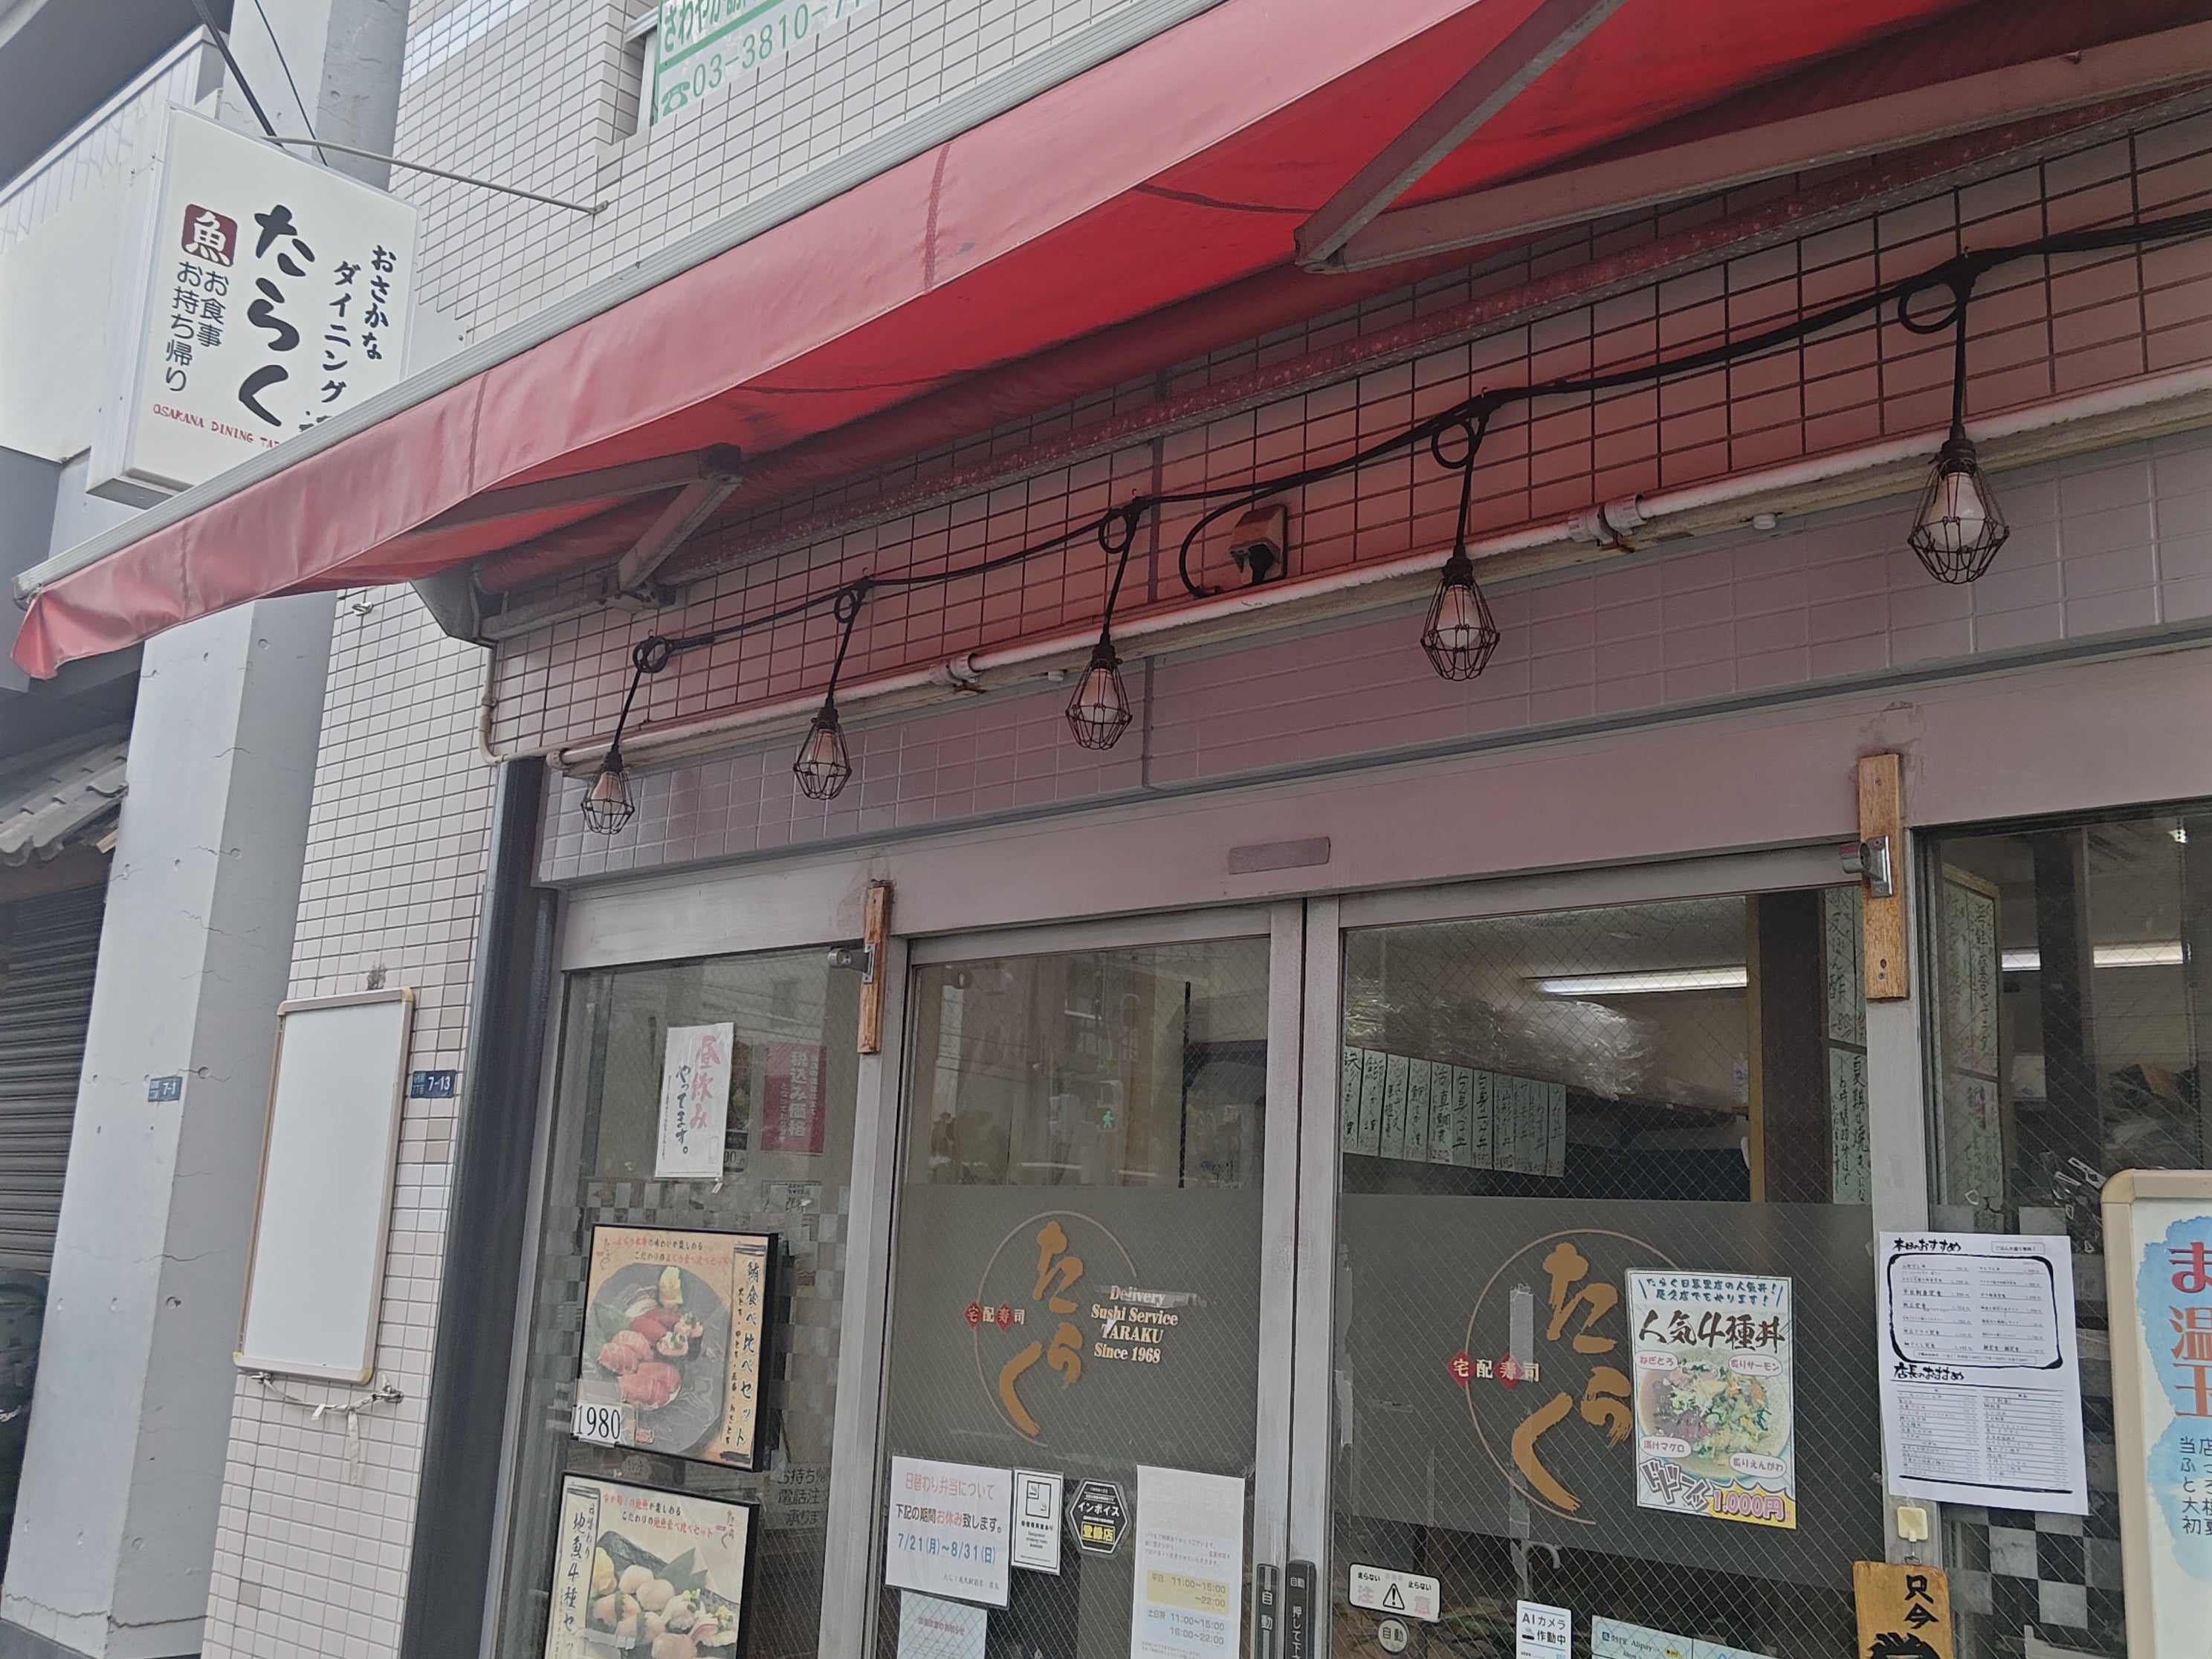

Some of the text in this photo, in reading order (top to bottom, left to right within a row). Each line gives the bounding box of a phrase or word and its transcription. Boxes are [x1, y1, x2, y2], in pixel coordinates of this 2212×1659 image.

[693, 0, 858, 97] 03-3810-7
[186, 210, 230, 267] 魚
[196, 271, 228, 348] お食事
[362, 245, 396, 360] おさかな
[166, 262, 203, 392] お持ち帰り
[239, 204, 315, 427] たらく
[322, 260, 361, 403] ダイニング
[153, 404, 204, 428] OSAKANA
[211, 421, 253, 443] DINING
[163, 1082, 177, 1095] 7-1
[428, 1076, 450, 1091] 7-13
[789, 1051, 808, 1136] 税込み価格
[1894, 1238, 1962, 1252] 本日のおすすめ
[1110, 1285, 1165, 1306] Delivery
[966, 1304, 1025, 1326] 宅配寿司
[1091, 1304, 1179, 1326] Sushi Service
[999, 1221, 1084, 1435] たらく
[1101, 1323, 1164, 1344] TARAKU
[1639, 1309, 1785, 1354] 人気4種丼
[1094, 1342, 1161, 1363] Since 1968
[1640, 1355, 1675, 1366] ねぎとろ
[1452, 1358, 1540, 1382] 宅配寿司
[1511, 1241, 1633, 1512] たらく
[1732, 1359, 1780, 1372] 炙りサーモン
[1894, 1362, 1964, 1380] 店長のおすすめ
[576, 1405, 621, 1440] 1980
[1644, 1440, 1684, 1452] 漬けマグロ
[1733, 1458, 1783, 1472] 炙りえんがわ
[905, 1472, 995, 1500] 日替わり弁当について
[896, 1504, 1002, 1533] 下記の期間お休み致します。
[1083, 1524, 1113, 1542] 登録店
[1357, 1572, 1381, 1582] 走らない
[1408, 1580, 1432, 1591] 止らない
[1261, 1591, 1273, 1630] 自動
[1904, 1575, 1939, 1629] 只今
[1292, 1605, 1302, 1659] 押して下
[1522, 1612, 1565, 1630] AIカメラ
[1382, 1627, 1404, 1642] 自動
[1537, 1630, 1565, 1645] 作動中
